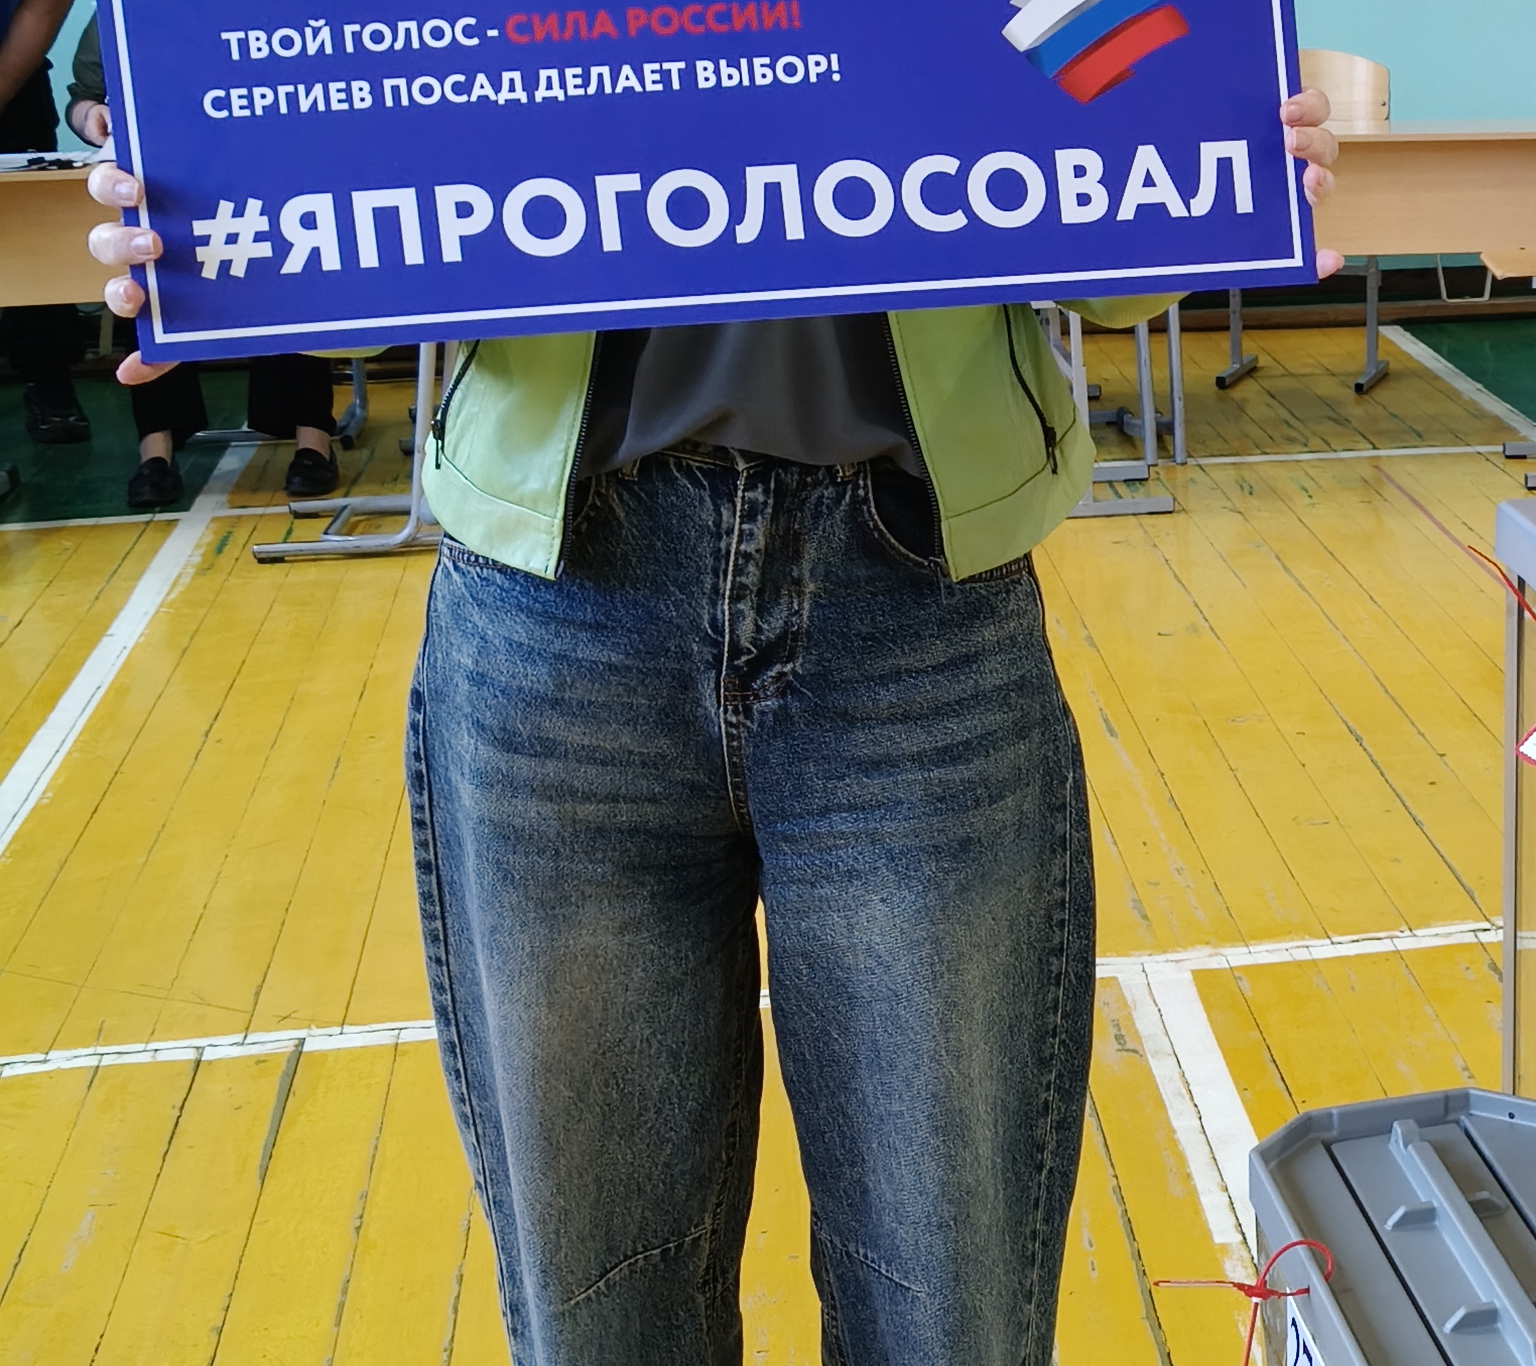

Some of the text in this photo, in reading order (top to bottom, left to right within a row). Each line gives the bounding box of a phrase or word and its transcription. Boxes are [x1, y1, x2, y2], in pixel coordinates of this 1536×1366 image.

[220, 19, 333, 61] ТВОЙ
[344, 16, 479, 54] ГОЛОС
[505, 9, 622, 45] СИЛА
[202, 53, 841, 120] СЕРГИЕВ ПОСАД ДЕЛАЕТ ВЫБОР!
[192, 139, 1255, 282] #ЯПРОГОЛОСОВАЛ
